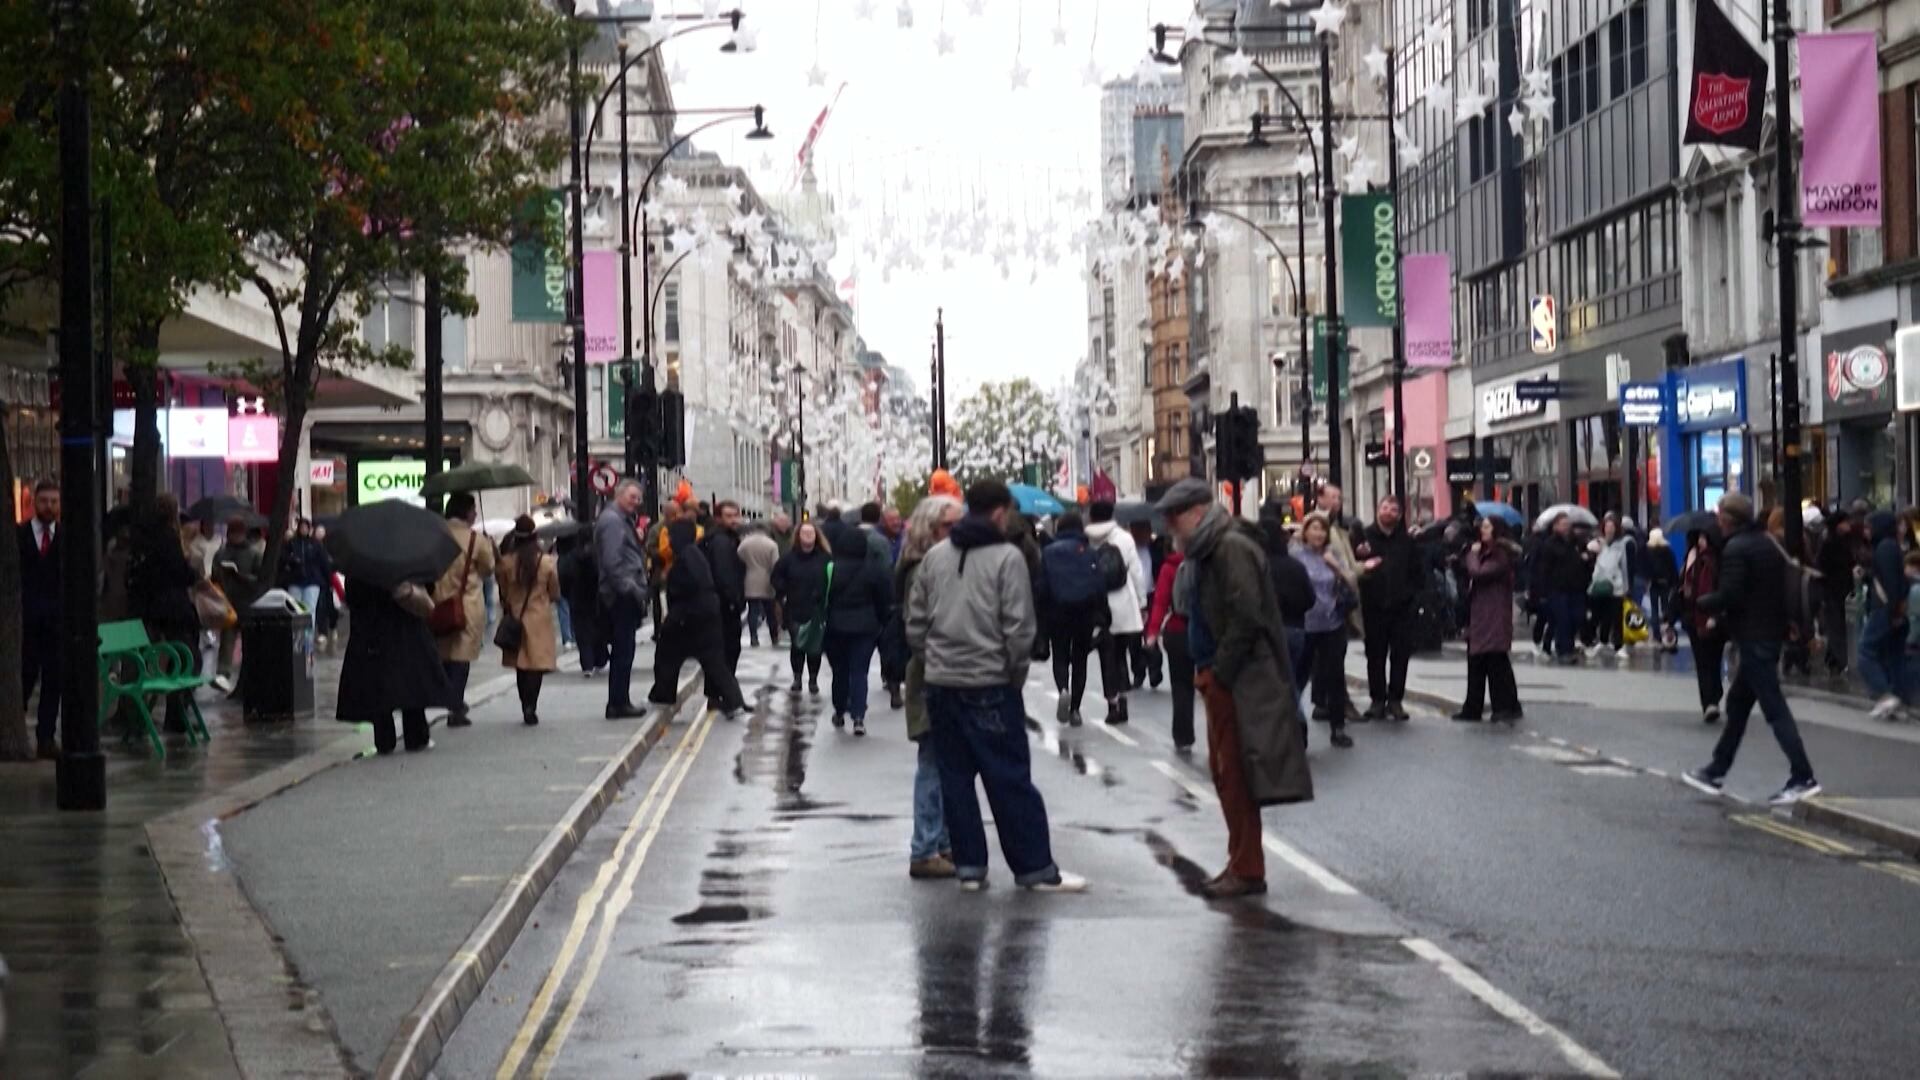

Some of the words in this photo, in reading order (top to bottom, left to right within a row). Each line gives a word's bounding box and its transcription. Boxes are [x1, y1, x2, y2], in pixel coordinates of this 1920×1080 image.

[1708, 81, 1725, 95] THE
[1698, 86, 1745, 116] SALVATION
[1712, 105, 1741, 123] ARMY
[1806, 183, 1862, 197] MAYOR
[1864, 183, 1877, 192] OF
[1806, 198, 1878, 213] LONDON
[1374, 201, 1396, 301] OXFORD
